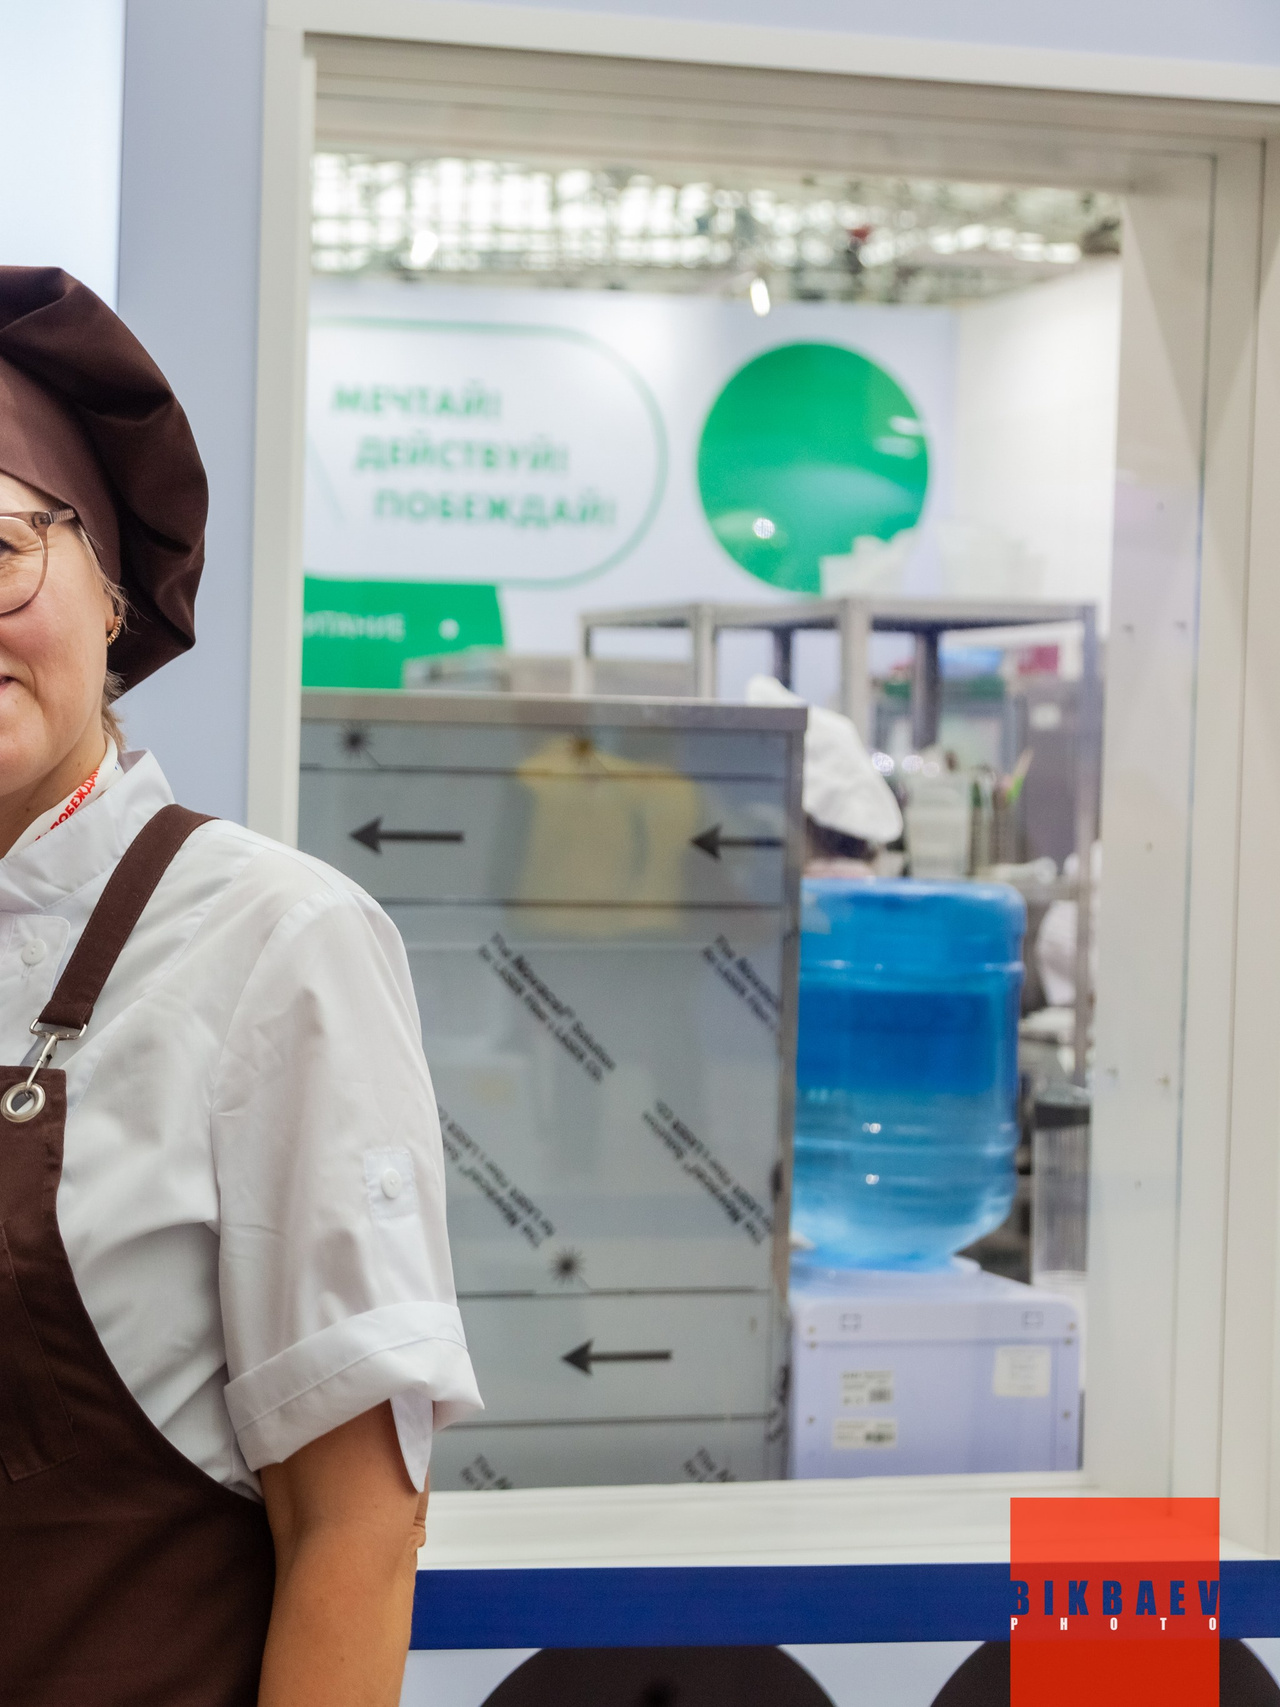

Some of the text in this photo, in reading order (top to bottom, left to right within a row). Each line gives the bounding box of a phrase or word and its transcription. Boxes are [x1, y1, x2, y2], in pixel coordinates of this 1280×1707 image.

[332, 379, 503, 418] МЕЧТАЙ!
[355, 427, 569, 471] ДЕЙСТВУЙ!
[374, 486, 616, 529] ПОБЕЖДАЙ!
